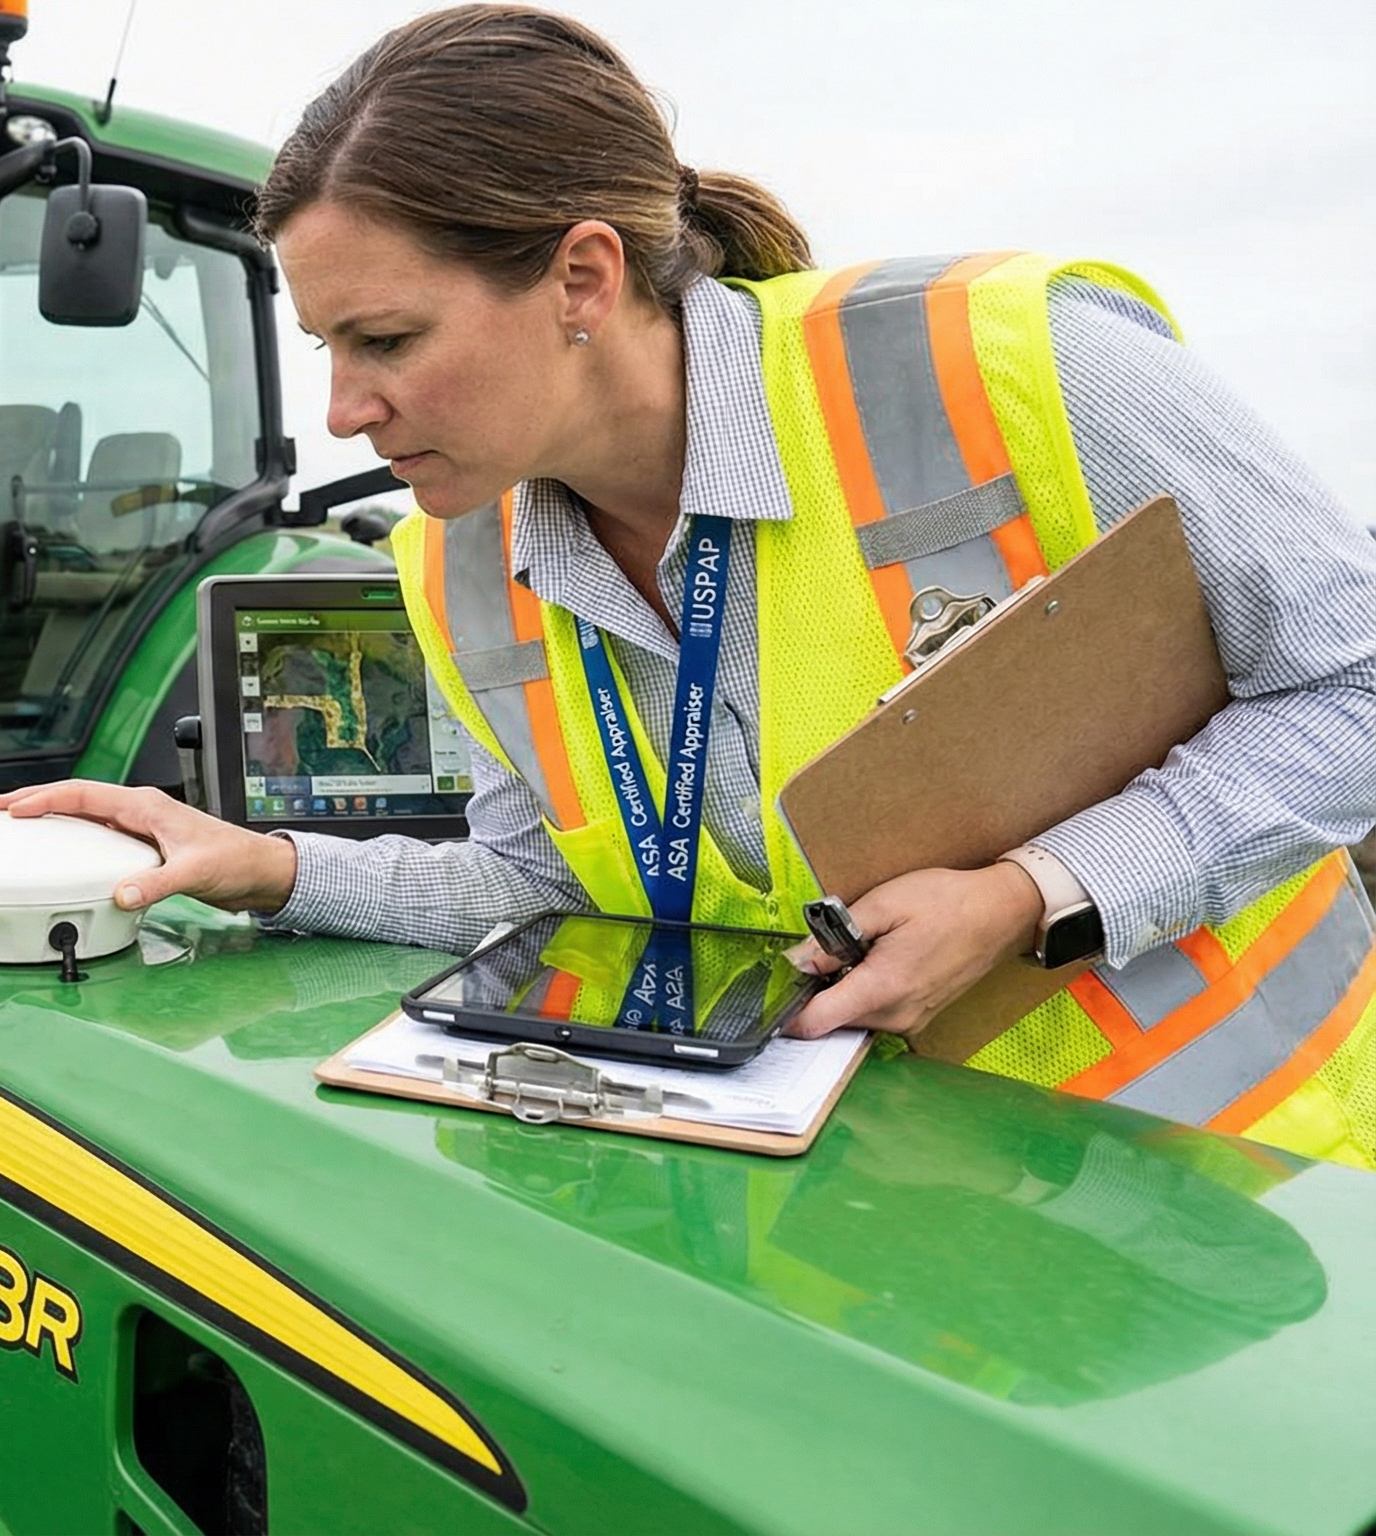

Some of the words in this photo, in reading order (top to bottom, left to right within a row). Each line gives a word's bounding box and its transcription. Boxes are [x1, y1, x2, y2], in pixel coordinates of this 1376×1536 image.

[691, 537, 720, 620] USPAP
[597, 687, 627, 758] Appraiser
[679, 682, 705, 760] Appraiser
[613, 762, 648, 827] Certified
[672, 762, 696, 828] Certified
[667, 837, 690, 882] ASA
